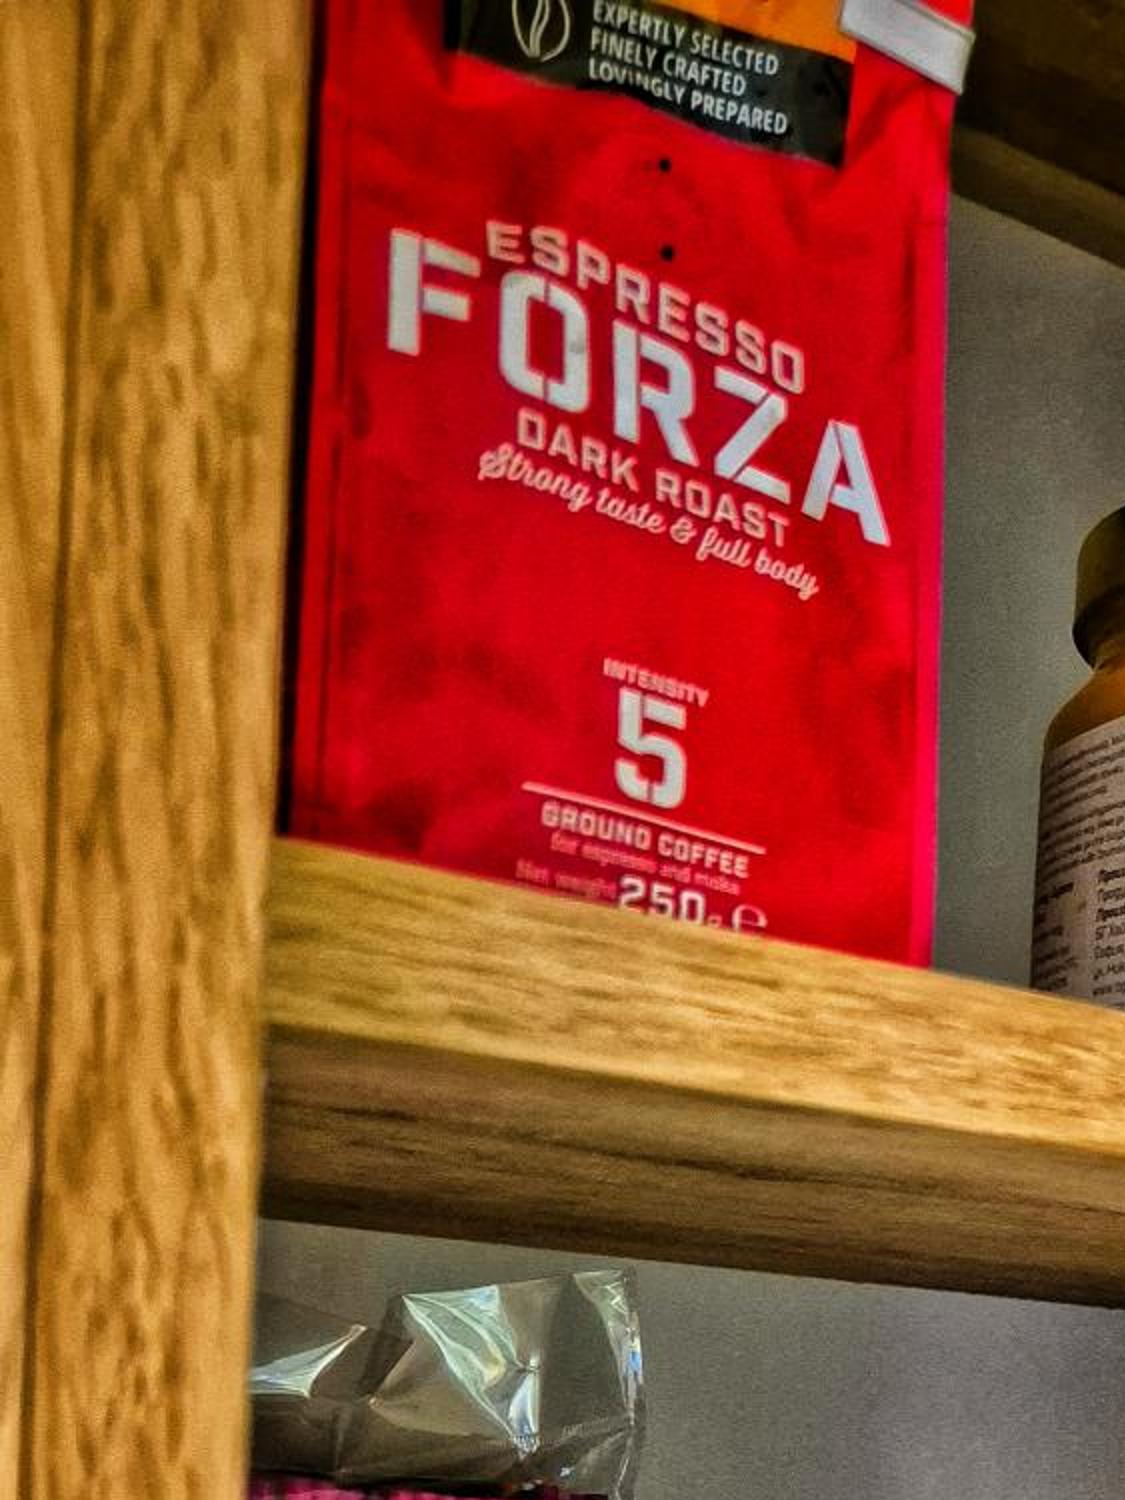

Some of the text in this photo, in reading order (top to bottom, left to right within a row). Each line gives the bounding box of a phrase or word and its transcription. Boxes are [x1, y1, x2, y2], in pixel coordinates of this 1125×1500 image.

[591, 27, 747, 95] FINELY CRAFTED
[593, 1, 779, 75] EXPERTLY SELECTED
[589, 59, 788, 135] LOVINGLY PREPARED
[486, 220, 804, 395] ESPRESSO
[387, 227, 890, 547] FORZA
[478, 442, 819, 601] Strong taste & full body
[517, 407, 791, 547] DARK ROAST
[603, 657, 709, 707] INTENSITY
[614, 686, 687, 810] 5
[541, 800, 749, 878] GROUND COFFEE
